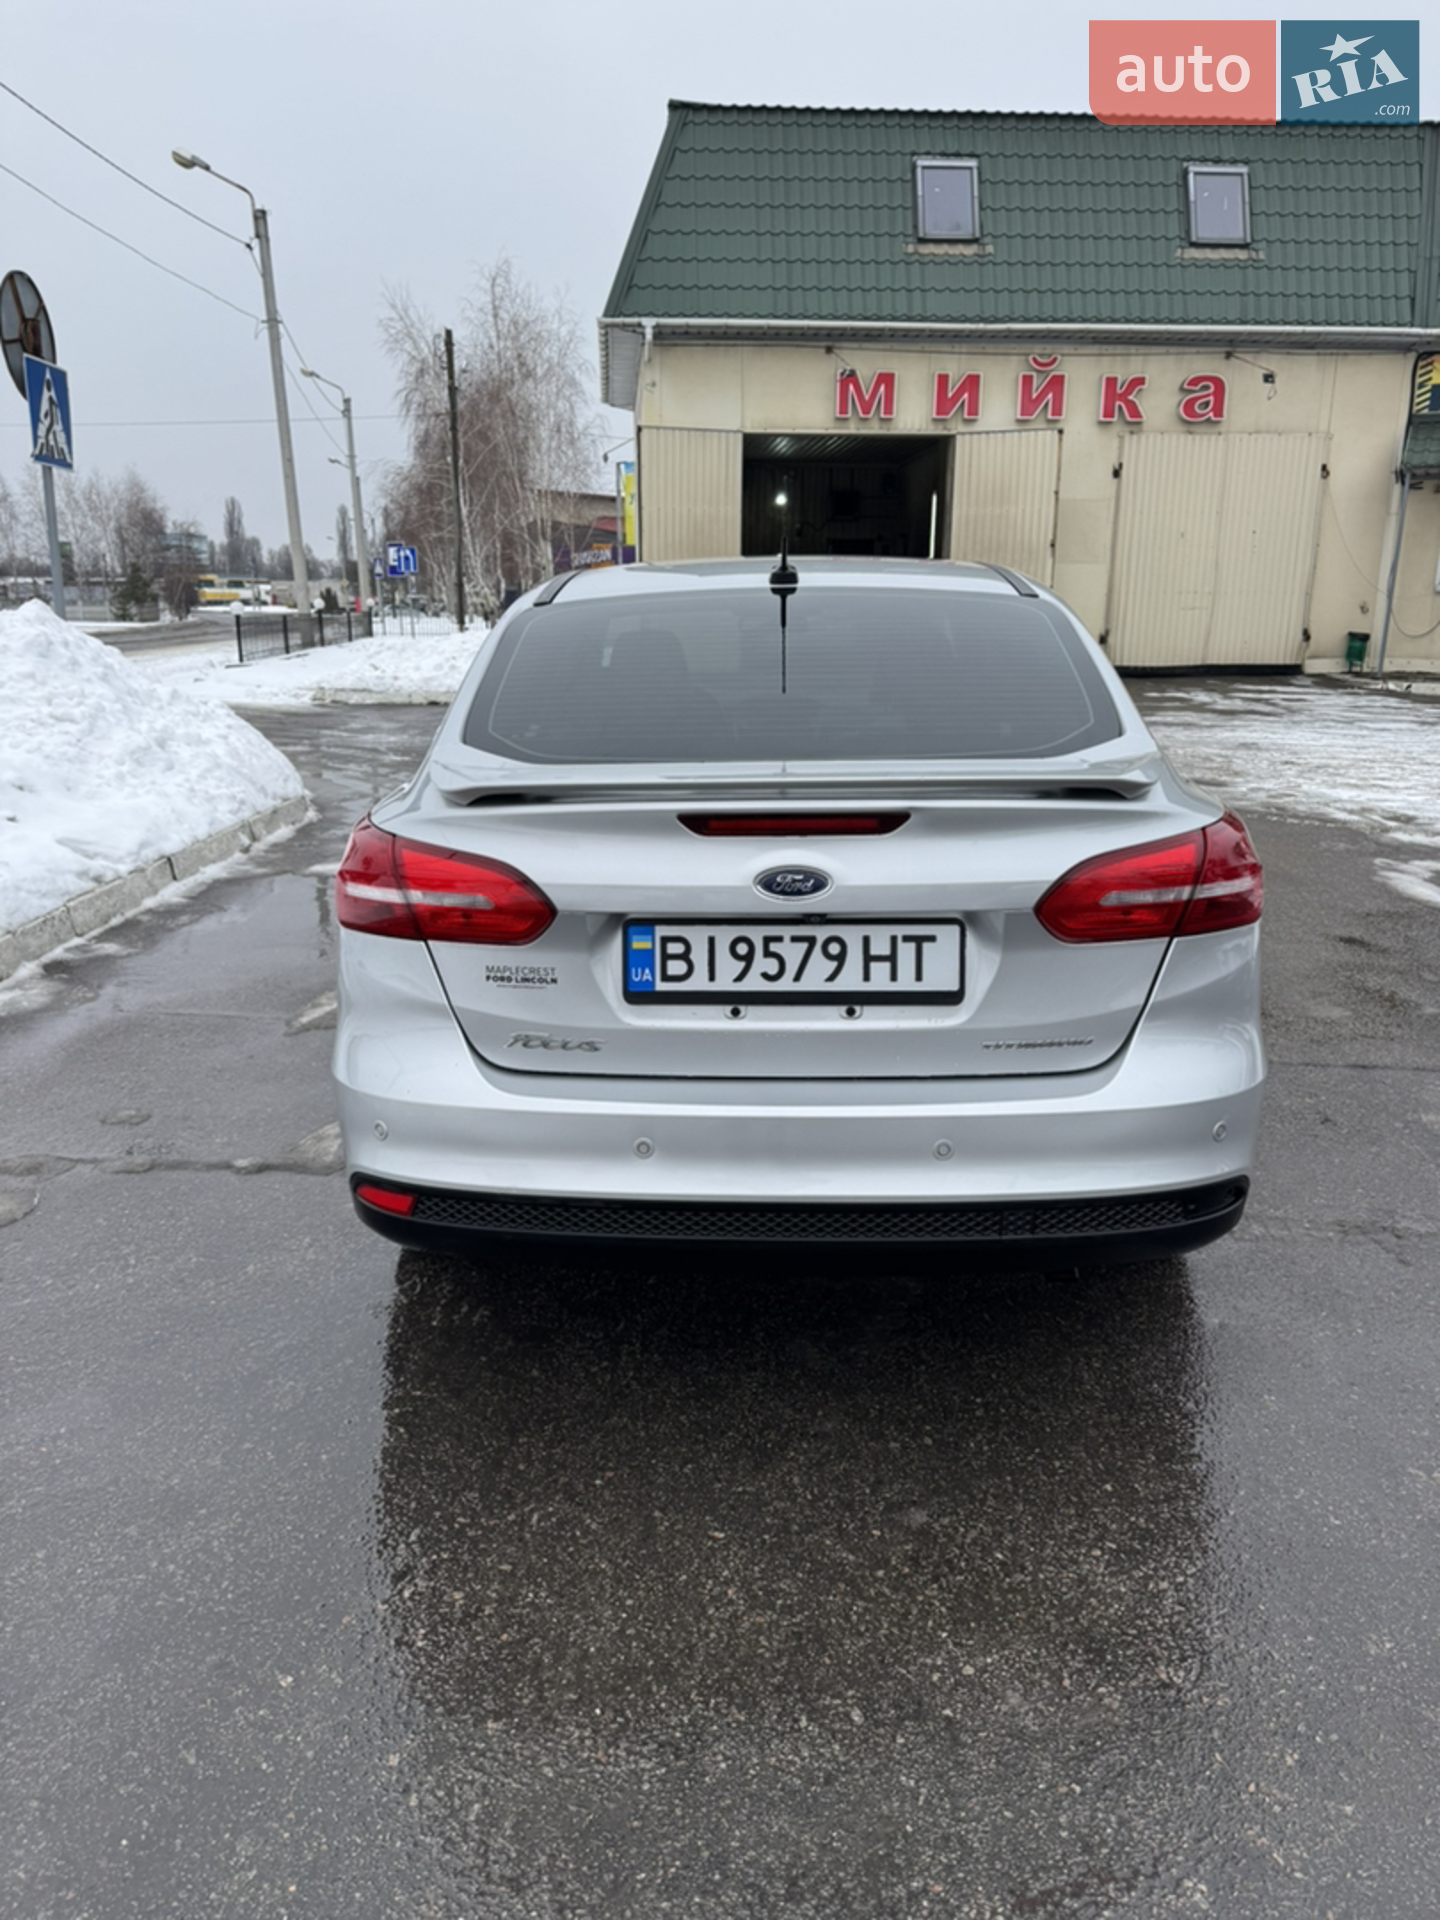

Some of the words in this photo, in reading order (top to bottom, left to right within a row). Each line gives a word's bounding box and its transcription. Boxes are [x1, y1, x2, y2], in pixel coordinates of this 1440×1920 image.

[772, 873, 815, 892] Ford
[485, 964, 557, 977] MAPLECREST
[631, 967, 653, 983] UA
[485, 974, 513, 984] FORD
[515, 976, 558, 985] LINCOLN
